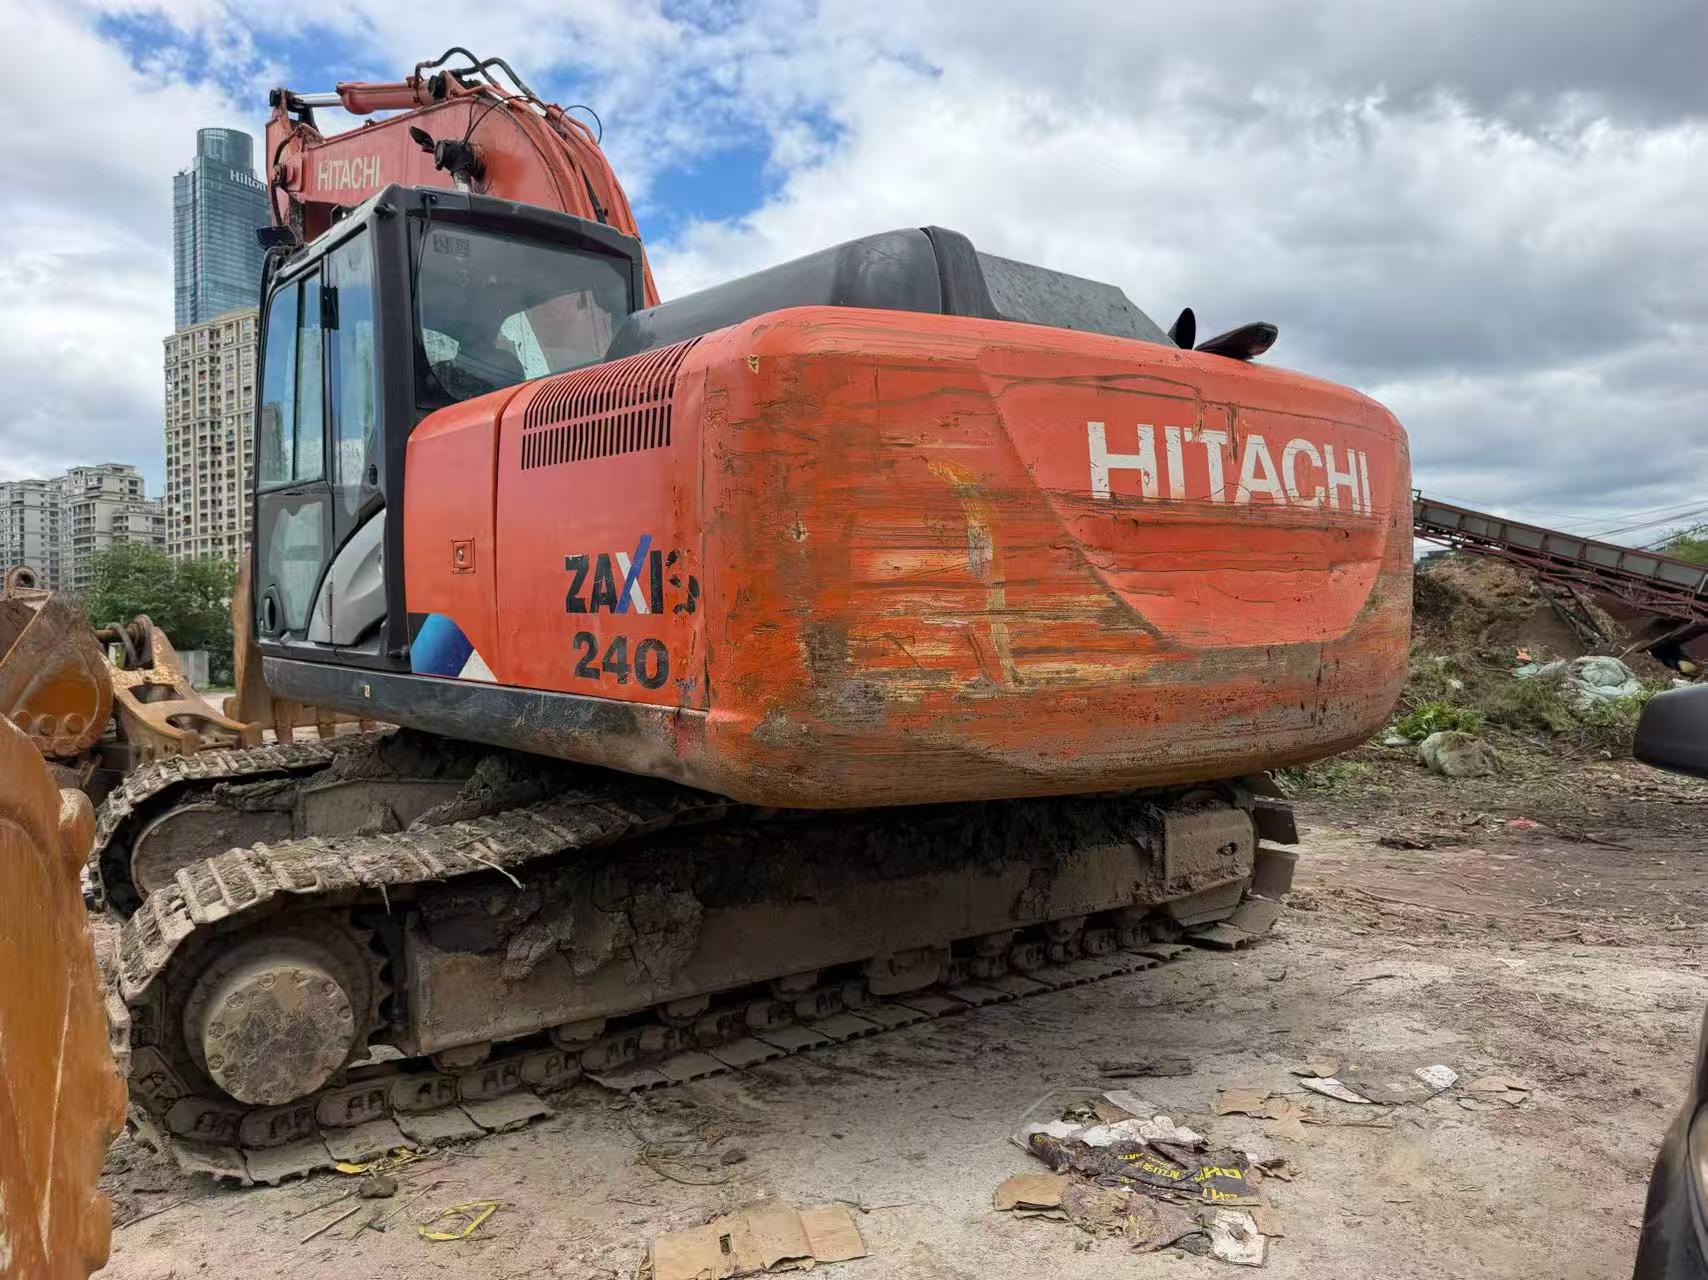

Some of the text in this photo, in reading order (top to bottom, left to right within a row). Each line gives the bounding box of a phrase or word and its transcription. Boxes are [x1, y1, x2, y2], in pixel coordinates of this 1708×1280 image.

[230, 168, 266, 191] Hilton
[317, 155, 380, 191] HITACHI
[1087, 421, 1372, 517] HITACHI
[572, 630, 670, 690] 240
